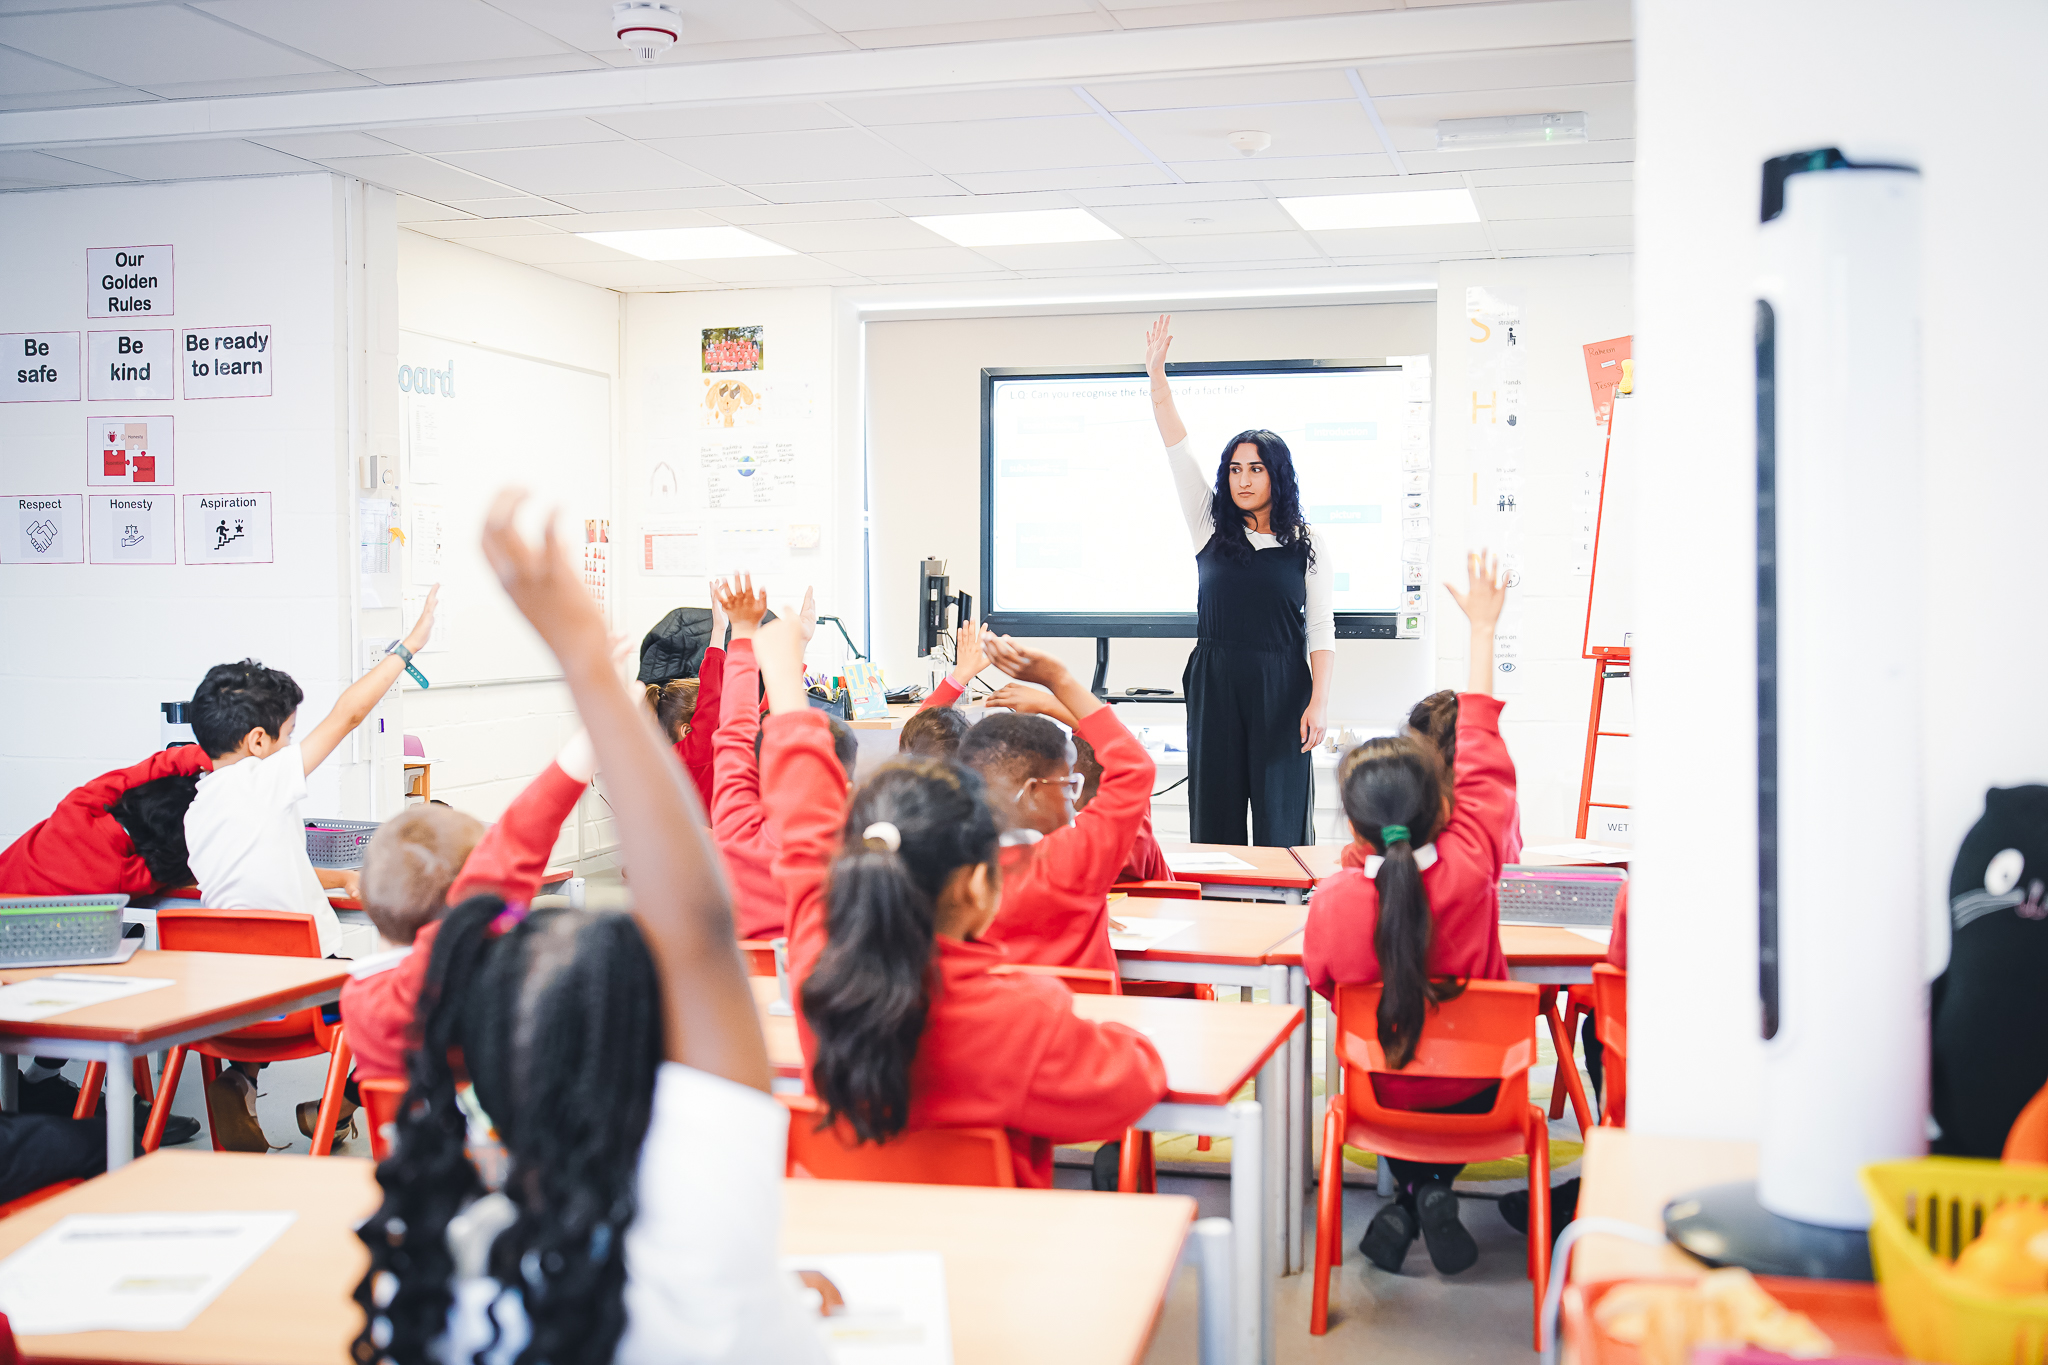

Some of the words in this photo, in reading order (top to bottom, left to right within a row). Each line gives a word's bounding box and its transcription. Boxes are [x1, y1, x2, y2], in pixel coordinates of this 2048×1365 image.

[115, 252, 145, 267] Our
[102, 274, 158, 290] Golden
[108, 296, 152, 312] Rules
[1498, 318, 1521, 326] straight
[24, 339, 49, 356] Be
[118, 336, 144, 354] Be
[186, 334, 209, 351] Be
[214, 331, 269, 352] ready
[17, 365, 58, 383] safe
[110, 363, 151, 381] kind
[191, 360, 210, 376] to
[214, 359, 263, 375] learn
[398, 359, 456, 398] oard
[1031, 390, 1049, 399] Can
[1051, 391, 1069, 400] you
[1072, 389, 1118, 400] recognise
[1120, 388, 1137, 397] the
[1181, 386, 1192, 396] of
[1202, 386, 1221, 395] fact
[1224, 384, 1245, 394] file?
[1472, 390, 1497, 424] H
[1585, 470, 1590, 478] S
[19, 499, 63, 510] Respect
[109, 499, 153, 511] Honesty
[200, 497, 257, 510] Aspiration
[1329, 510, 1362, 521] picture
[1494, 651, 1517, 659] speaker
[844, 663, 877, 691] FLAT
[1607, 823, 1630, 832] WET
